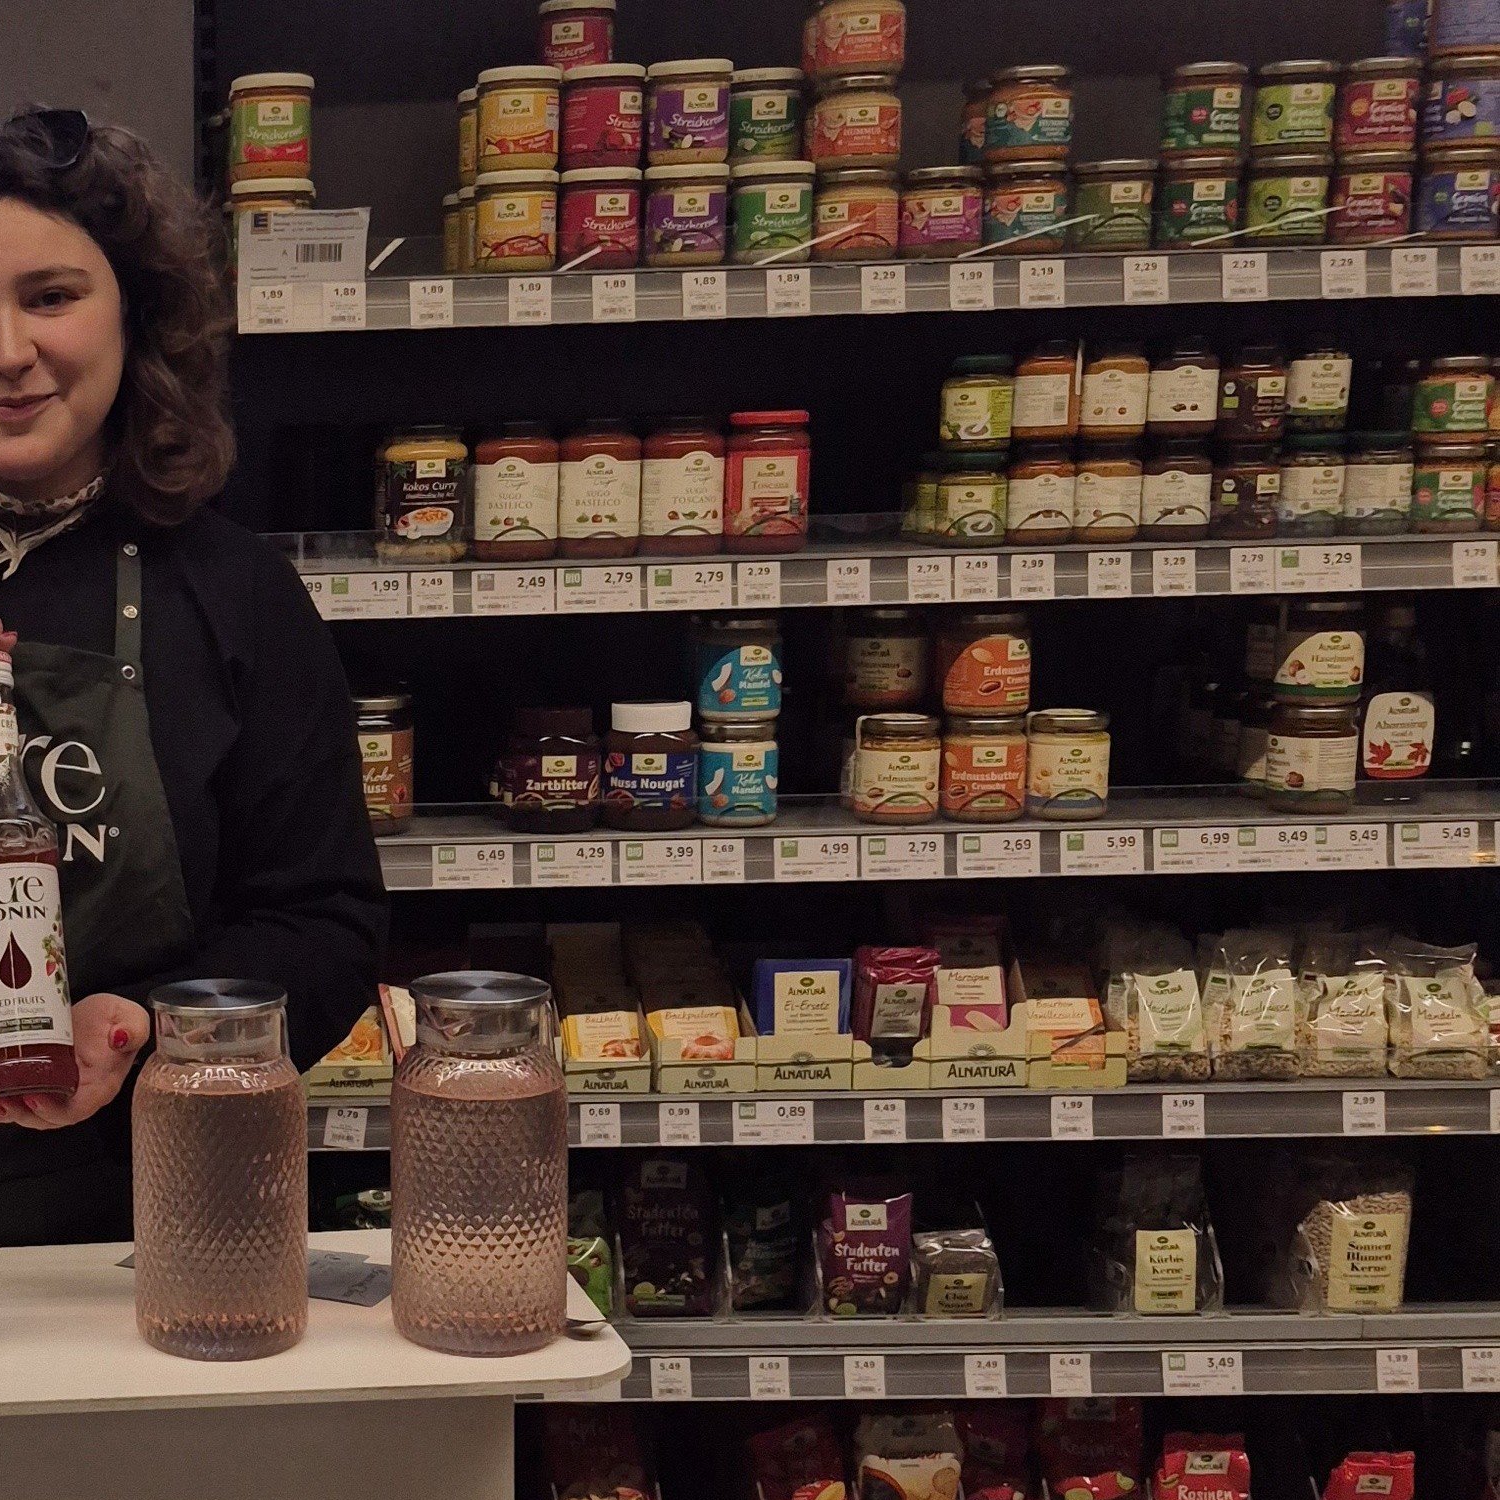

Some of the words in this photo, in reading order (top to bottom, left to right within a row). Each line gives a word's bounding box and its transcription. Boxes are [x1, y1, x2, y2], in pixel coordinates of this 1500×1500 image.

[1134, 262, 1158, 272] 2,29
[1232, 260, 1255, 269] 2,29
[872, 271, 896, 280] 2,29
[960, 271, 982, 280] 1,99
[1031, 267, 1054, 276] 2,19
[693, 276, 716, 286] 1,89
[778, 273, 800, 283] 1,89
[333, 286, 356, 297] 1,89
[421, 284, 444, 295] 1,89
[518, 282, 541, 293] 1,89
[261, 289, 284, 300] 1,89
[403, 482, 429, 492] Kokos
[432, 481, 458, 492] Curry
[1021, 559, 1044, 569] 2,99
[1098, 557, 1121, 567] 2,99
[1163, 557, 1186, 566] 3,29
[1241, 554, 1264, 563] 2,79
[1323, 552, 1352, 565] 3,29
[837, 566, 859, 575] 1,99
[917, 565, 940, 574] 2,79
[965, 561, 988, 570] 2,49
[747, 567, 770, 576] 2,29
[421, 578, 443, 587] 2,49
[517, 577, 546, 589] 2,49
[604, 572, 633, 585] 2,79
[695, 571, 724, 584] 2,79
[371, 580, 399, 591] 1,99
[526, 779, 589, 791] Zartbitter
[610, 777, 638, 789] Nuss
[641, 777, 685, 793] Nougat
[1200, 832, 1230, 845] 6,99
[1278, 830, 1308, 842] 8,49
[1349, 829, 1378, 841] 8,49
[1442, 827, 1471, 839] 5,49
[908, 841, 937, 853] 2,79
[1003, 839, 1031, 851] 2,69
[1107, 836, 1136, 848] 5,99
[576, 847, 605, 860] 4,29
[665, 846, 693, 859] 3,99
[712, 844, 734, 853] 2,69
[820, 842, 849, 855] 4,99
[477, 850, 505, 862] 6,49
[774, 1067, 832, 1080] ALNATURA
[947, 1063, 1016, 1078] ALNATURA
[583, 1079, 629, 1090] ALNATURA
[684, 1078, 729, 1089] ALNATURA
[874, 1103, 896, 1112] 4,49
[953, 1102, 975, 1111] 3,79
[1061, 1101, 1083, 1109] 1,99
[1173, 1099, 1195, 1108] 3,99
[589, 1108, 611, 1117] 0,69
[668, 1107, 690, 1117] 0,99
[777, 1106, 806, 1119] 0,89
[834, 1242, 900, 1257] Studenten
[846, 1258, 888, 1272] Futter
[977, 1360, 998, 1369] 2,49
[1207, 1357, 1235, 1369] 3,49
